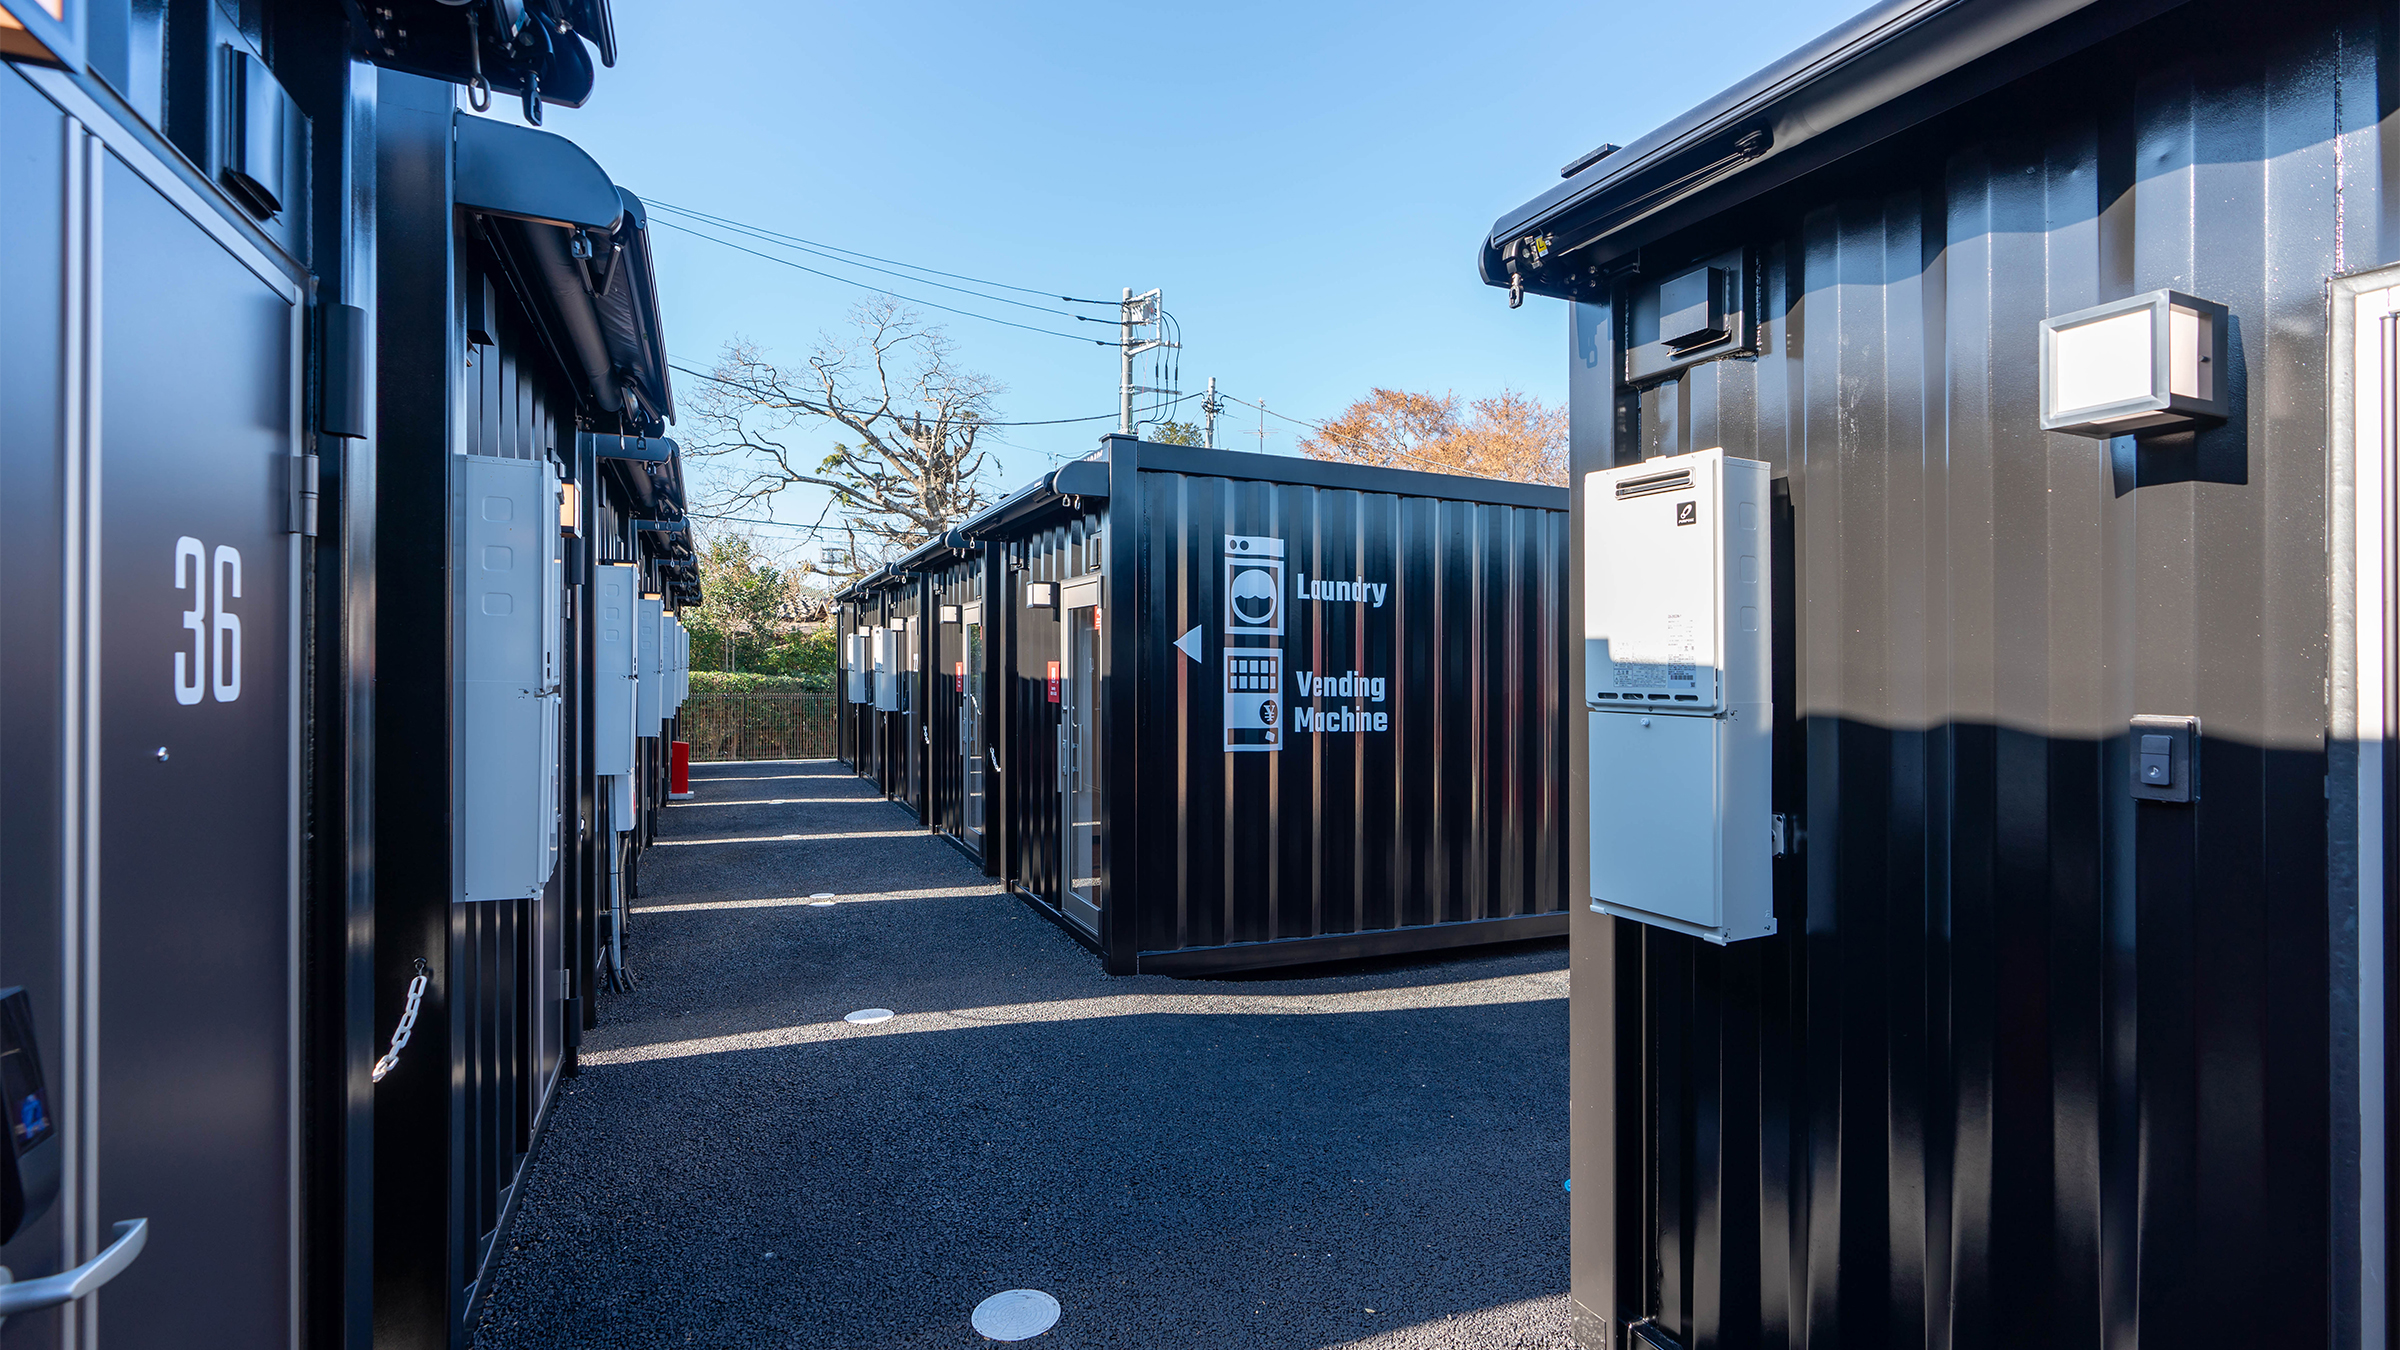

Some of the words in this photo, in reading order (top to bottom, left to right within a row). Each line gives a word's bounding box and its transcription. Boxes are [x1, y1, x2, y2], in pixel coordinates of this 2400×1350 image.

[1297, 573, 1387, 608] Laundry
[175, 535, 242, 706] 36
[1296, 670, 1386, 702] Vending
[1294, 705, 1388, 733] Machine
